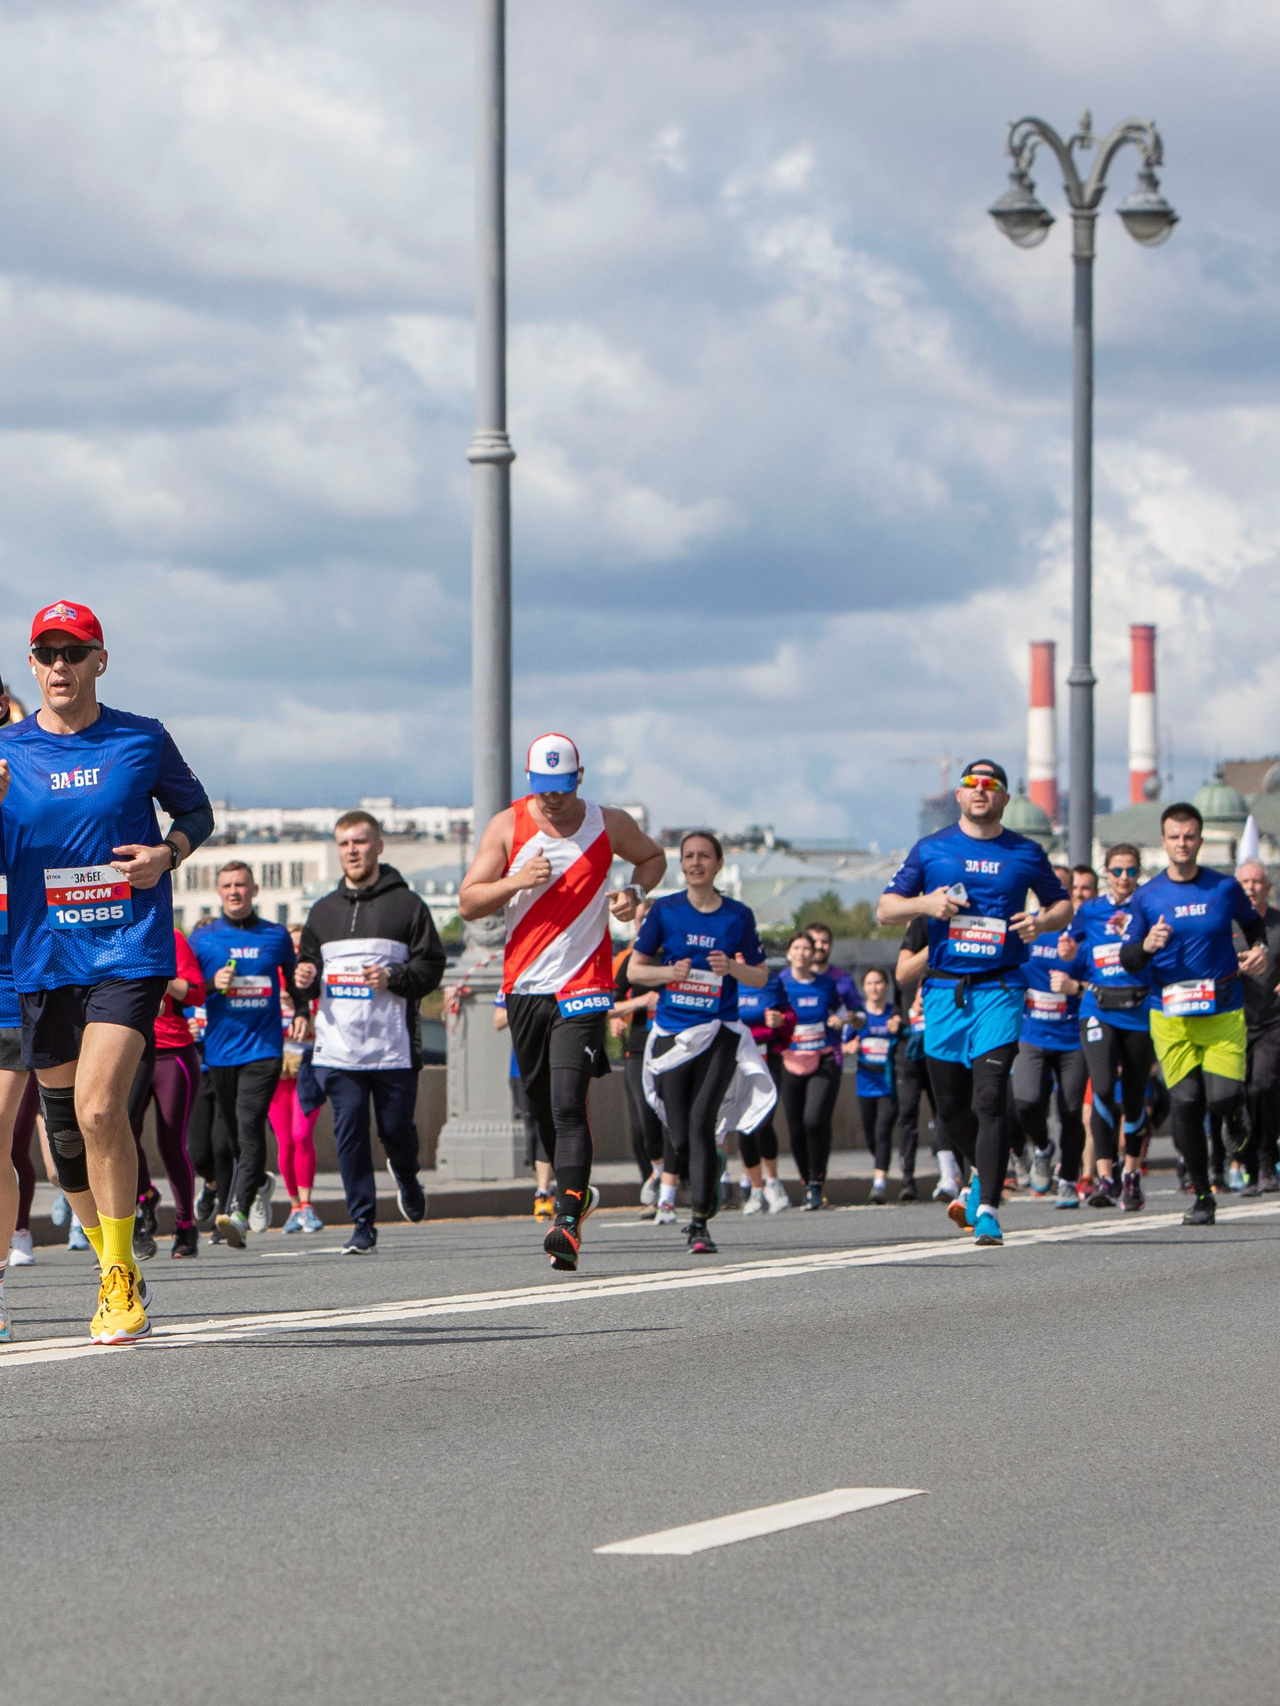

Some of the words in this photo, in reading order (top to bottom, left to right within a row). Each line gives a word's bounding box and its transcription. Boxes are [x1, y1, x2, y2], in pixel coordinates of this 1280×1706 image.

[55, 905, 124, 924] 10585
[953, 941, 997, 956] 10919
[564, 996, 611, 1013] 10458
[670, 994, 714, 1008] 12827
